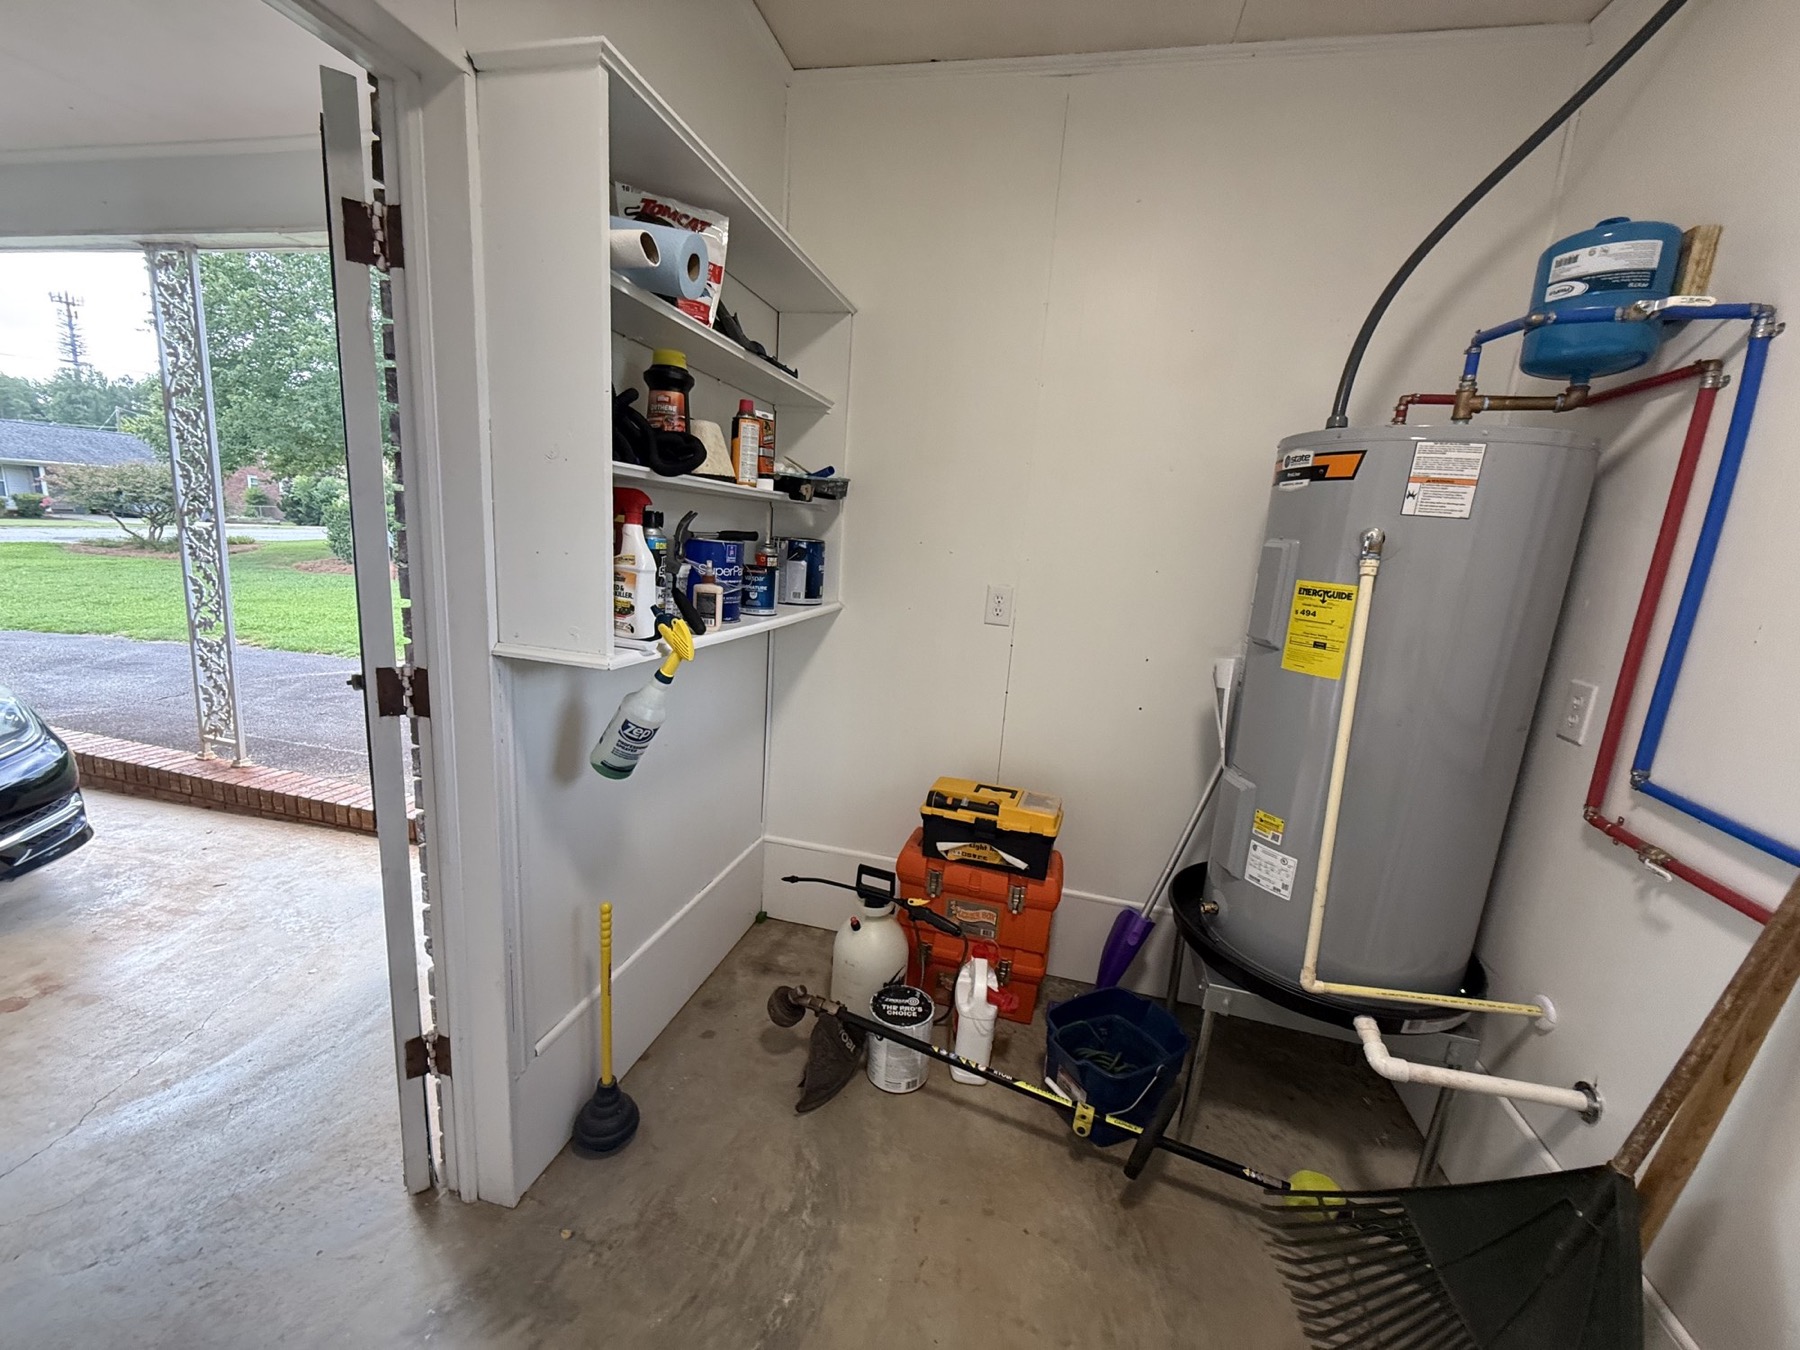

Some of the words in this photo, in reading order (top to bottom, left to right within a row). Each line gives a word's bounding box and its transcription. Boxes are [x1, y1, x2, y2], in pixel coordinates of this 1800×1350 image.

[641, 198, 712, 233] TOMCAT
[1291, 454, 1311, 462] state
[1298, 587, 1354, 601] ENERGYGUIDE
[1300, 609, 1316, 617] 494
[623, 723, 652, 740] Zep
